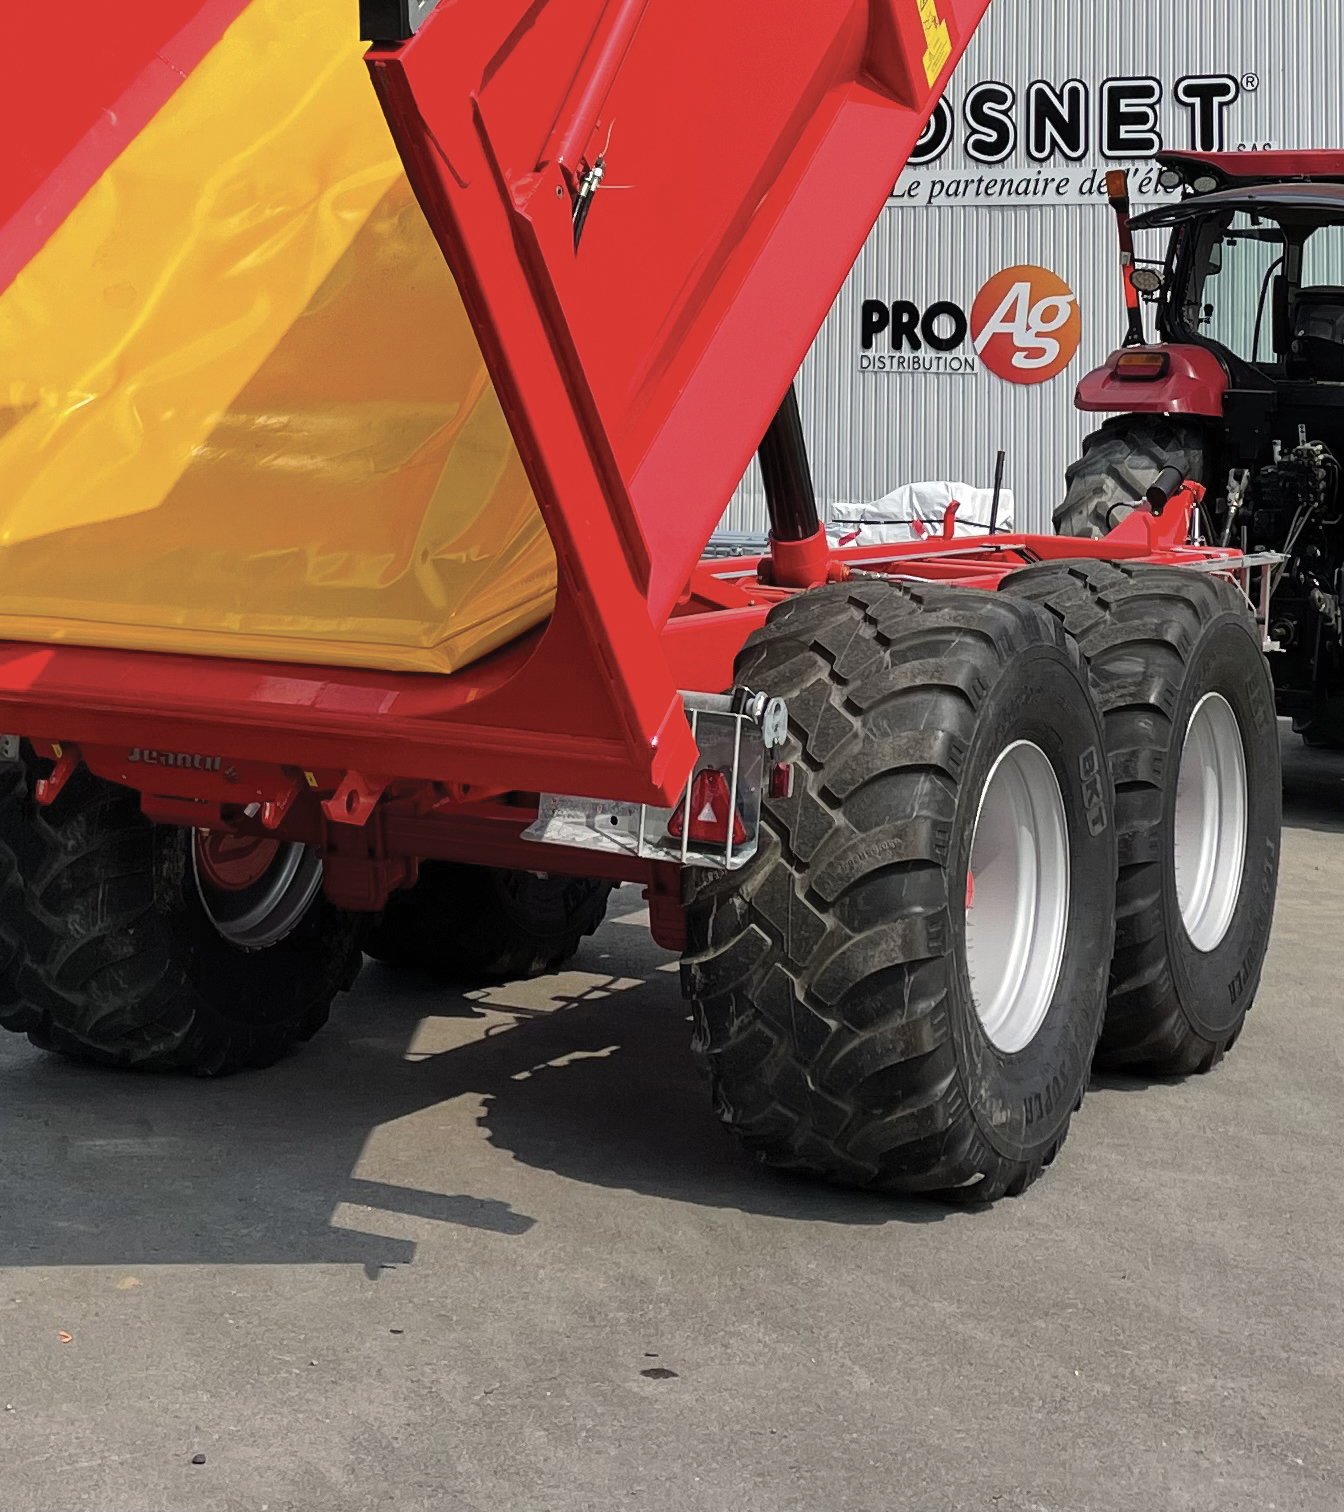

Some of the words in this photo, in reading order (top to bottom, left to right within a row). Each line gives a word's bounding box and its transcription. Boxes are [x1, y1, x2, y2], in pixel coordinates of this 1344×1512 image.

[926, 170, 1070, 204] partenaire
[861, 299, 968, 351] PRO
[973, 281, 1075, 369] Ag
[860, 354, 975, 371] DISTRIBUTION
